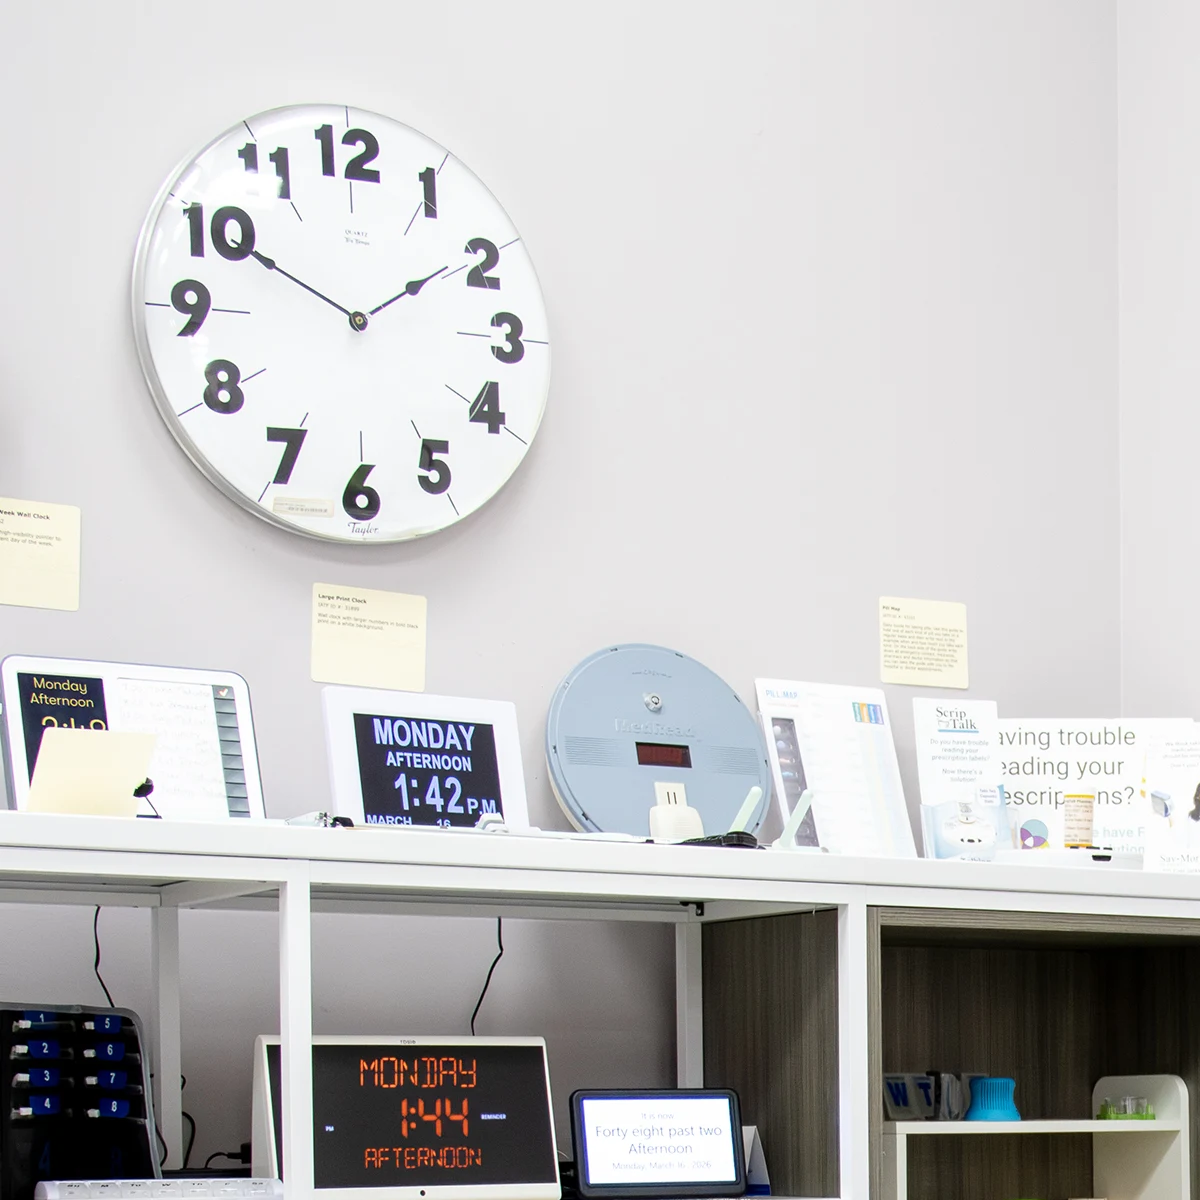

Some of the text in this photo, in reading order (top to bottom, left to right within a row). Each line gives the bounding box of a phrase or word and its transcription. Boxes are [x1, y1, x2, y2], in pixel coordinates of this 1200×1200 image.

[315, 124, 380, 183] 12
[238, 142, 290, 200] 11
[418, 167, 437, 218] 1
[183, 202, 255, 261] 10
[464, 238, 500, 290] 2
[171, 279, 211, 336] 9
[490, 312, 524, 364] 3
[203, 359, 244, 415] 8
[469, 381, 505, 434] 4
[266, 427, 308, 484] 7
[418, 438, 451, 495] 5
[342, 464, 380, 521] 6
[33, 677, 87, 695] Monday
[30, 693, 94, 708] Afternoon
[936, 706, 966, 720] Scrip
[950, 719, 977, 729] Talk
[373, 718, 475, 751] MONDAY
[1058, 726, 1135, 745] trouble
[386, 751, 472, 772] AFTERNOON
[1076, 761, 1124, 780] your
[394, 773, 464, 813] 1:42
[366, 814, 451, 828] MARCH 16
[39, 1014, 44, 1023] 1
[104, 1018, 110, 1028] 5
[42, 1043, 48, 1053] 2
[107, 1045, 113, 1055] 6
[44, 1071, 50, 1081] 3
[110, 1073, 116, 1083] 7
[360, 1057, 476, 1088] MONDAY
[44, 1098, 50, 1108] 4
[886, 1082, 909, 1106] W
[917, 1082, 932, 1106] T
[111, 1101, 117, 1112] 8
[401, 1098, 468, 1138] 1:44
[596, 1126, 722, 1140] Forty eight past two
[364, 1147, 482, 1169] AFTERNOON
[629, 1143, 693, 1154] Afternoon
